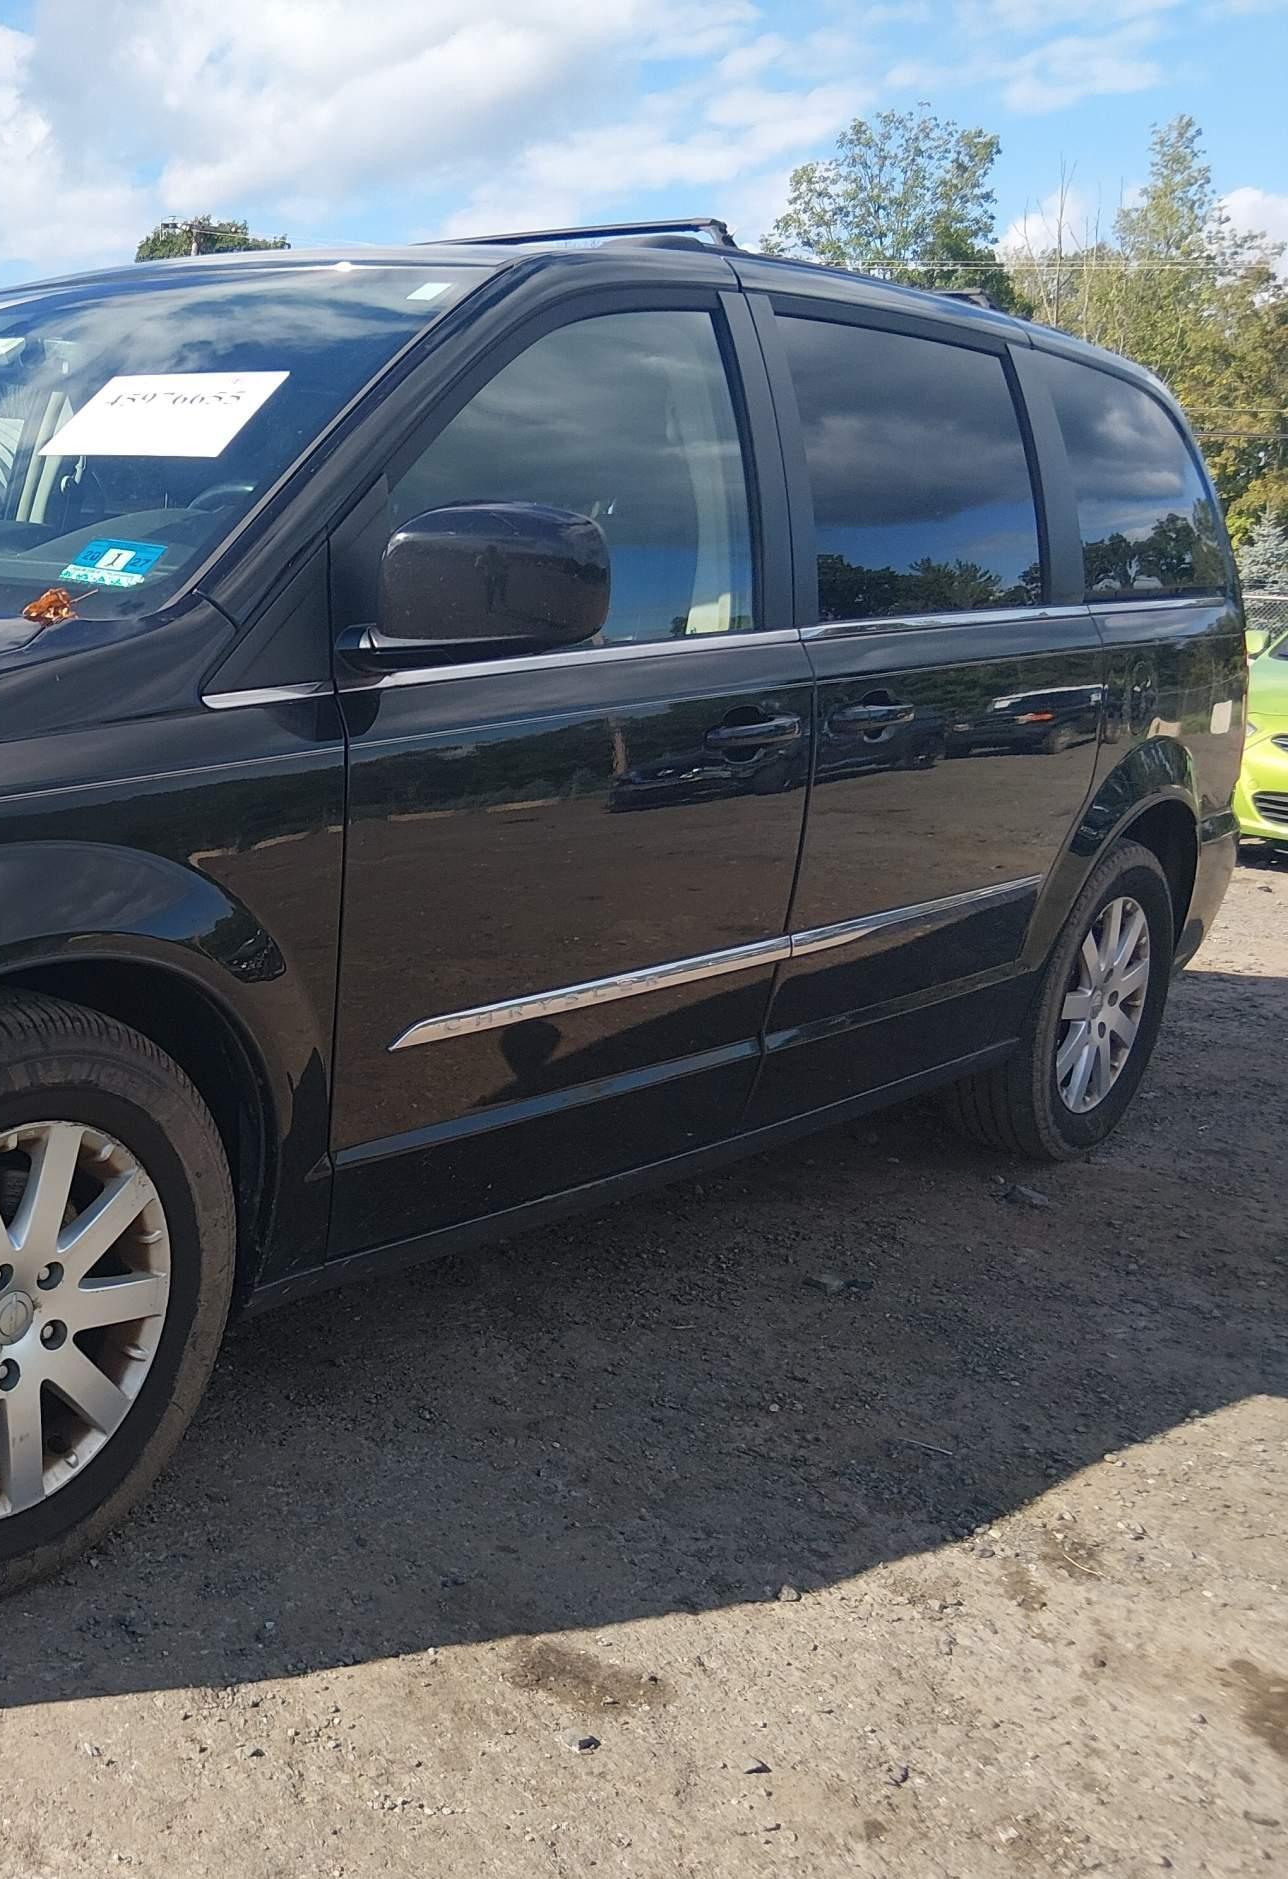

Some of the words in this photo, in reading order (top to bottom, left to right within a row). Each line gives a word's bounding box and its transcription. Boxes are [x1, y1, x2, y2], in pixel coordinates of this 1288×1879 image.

[82, 550, 102, 561] 20
[129, 557, 151, 567] 27
[443, 975, 660, 1032] CHRYSLER
